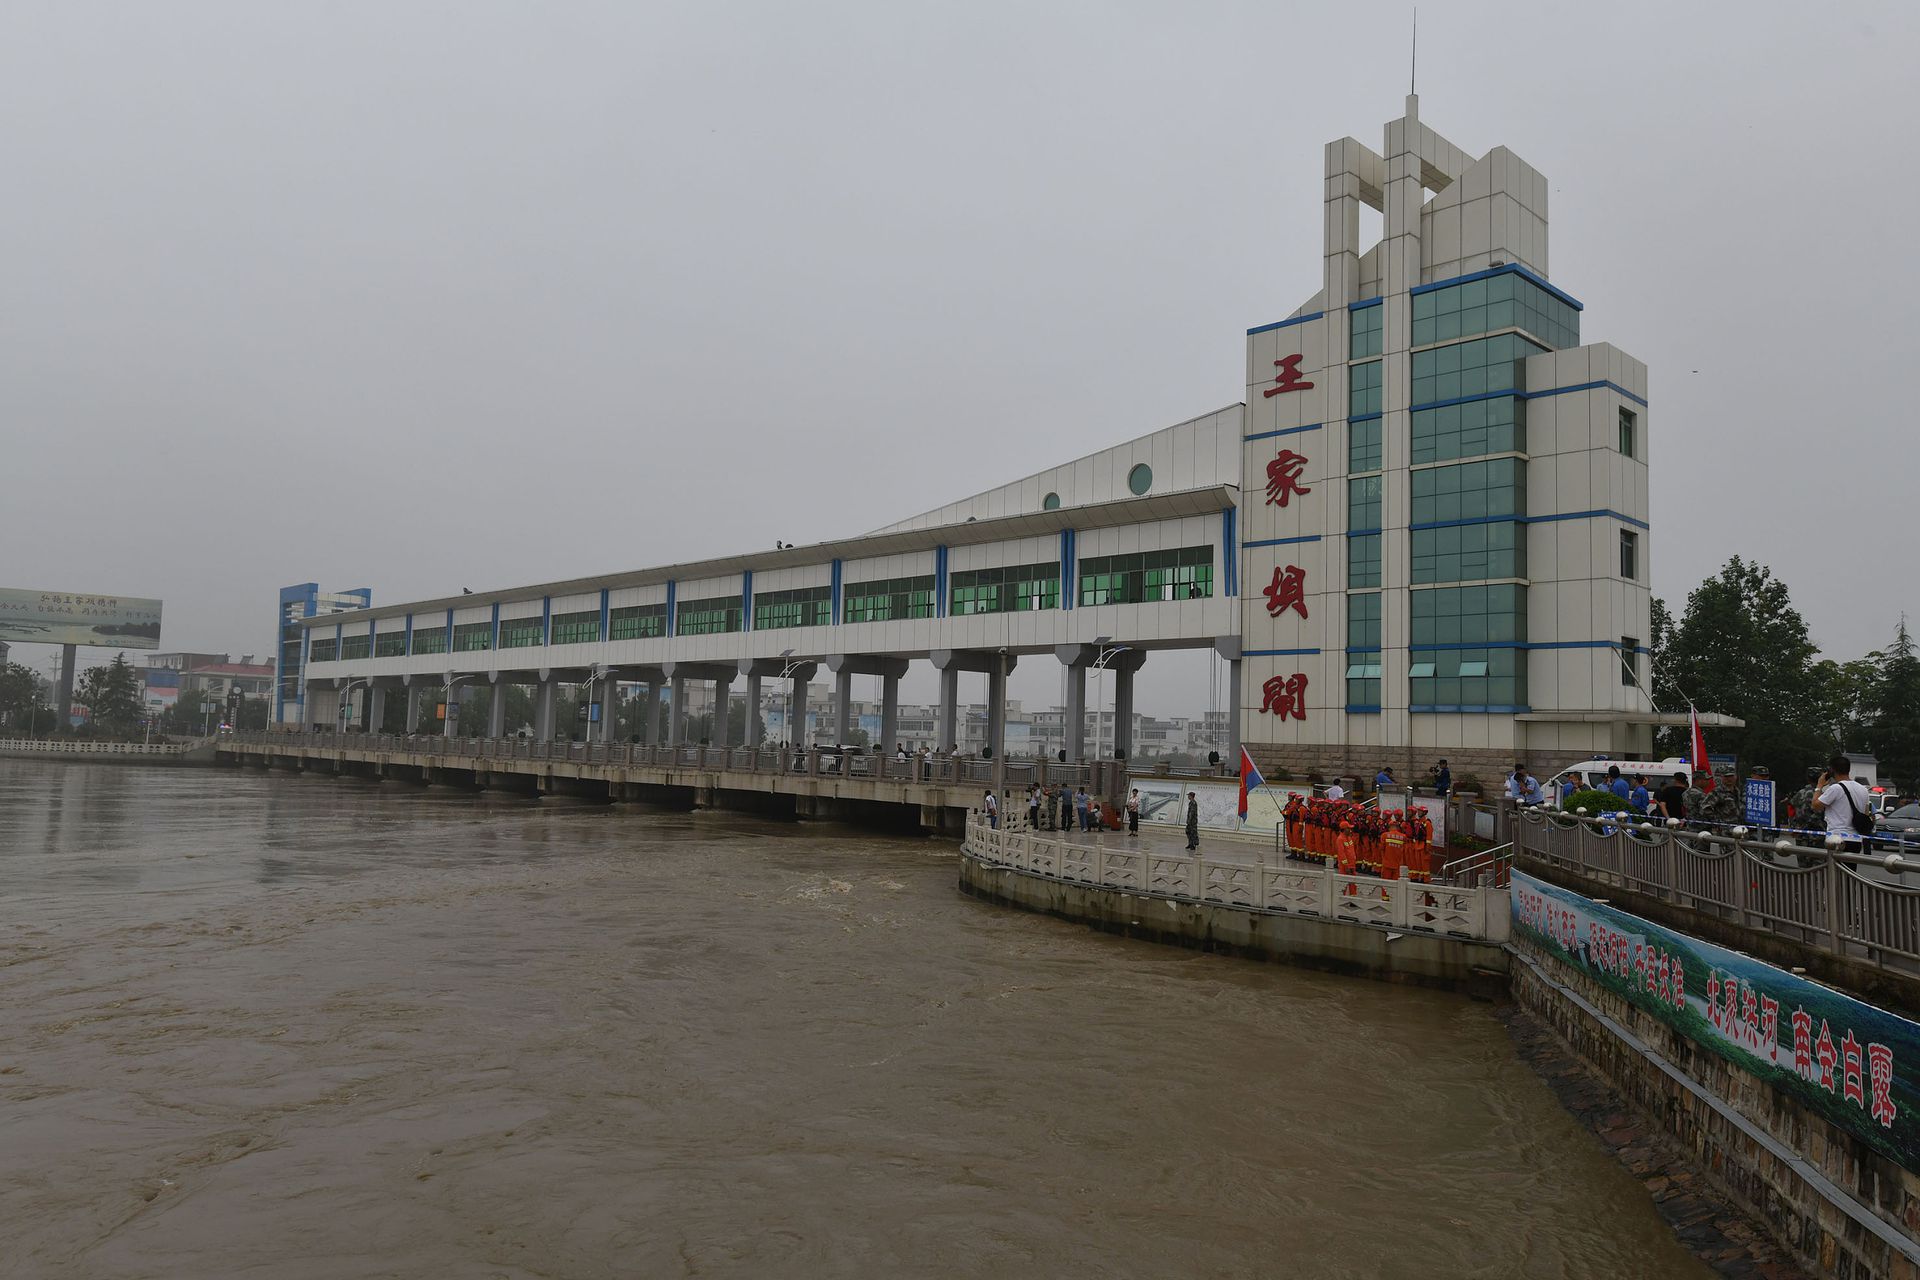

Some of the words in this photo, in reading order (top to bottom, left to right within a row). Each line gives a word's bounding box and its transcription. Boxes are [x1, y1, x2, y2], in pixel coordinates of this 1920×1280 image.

[1747, 783, 1770, 798] 水深危险
[1747, 797, 1770, 813] 禁止游泳
[1634, 943, 1686, 1012] 千里长淮
[1706, 969, 1779, 1062] 北聚洪河
[1791, 1004, 1897, 1129] 南会白露
